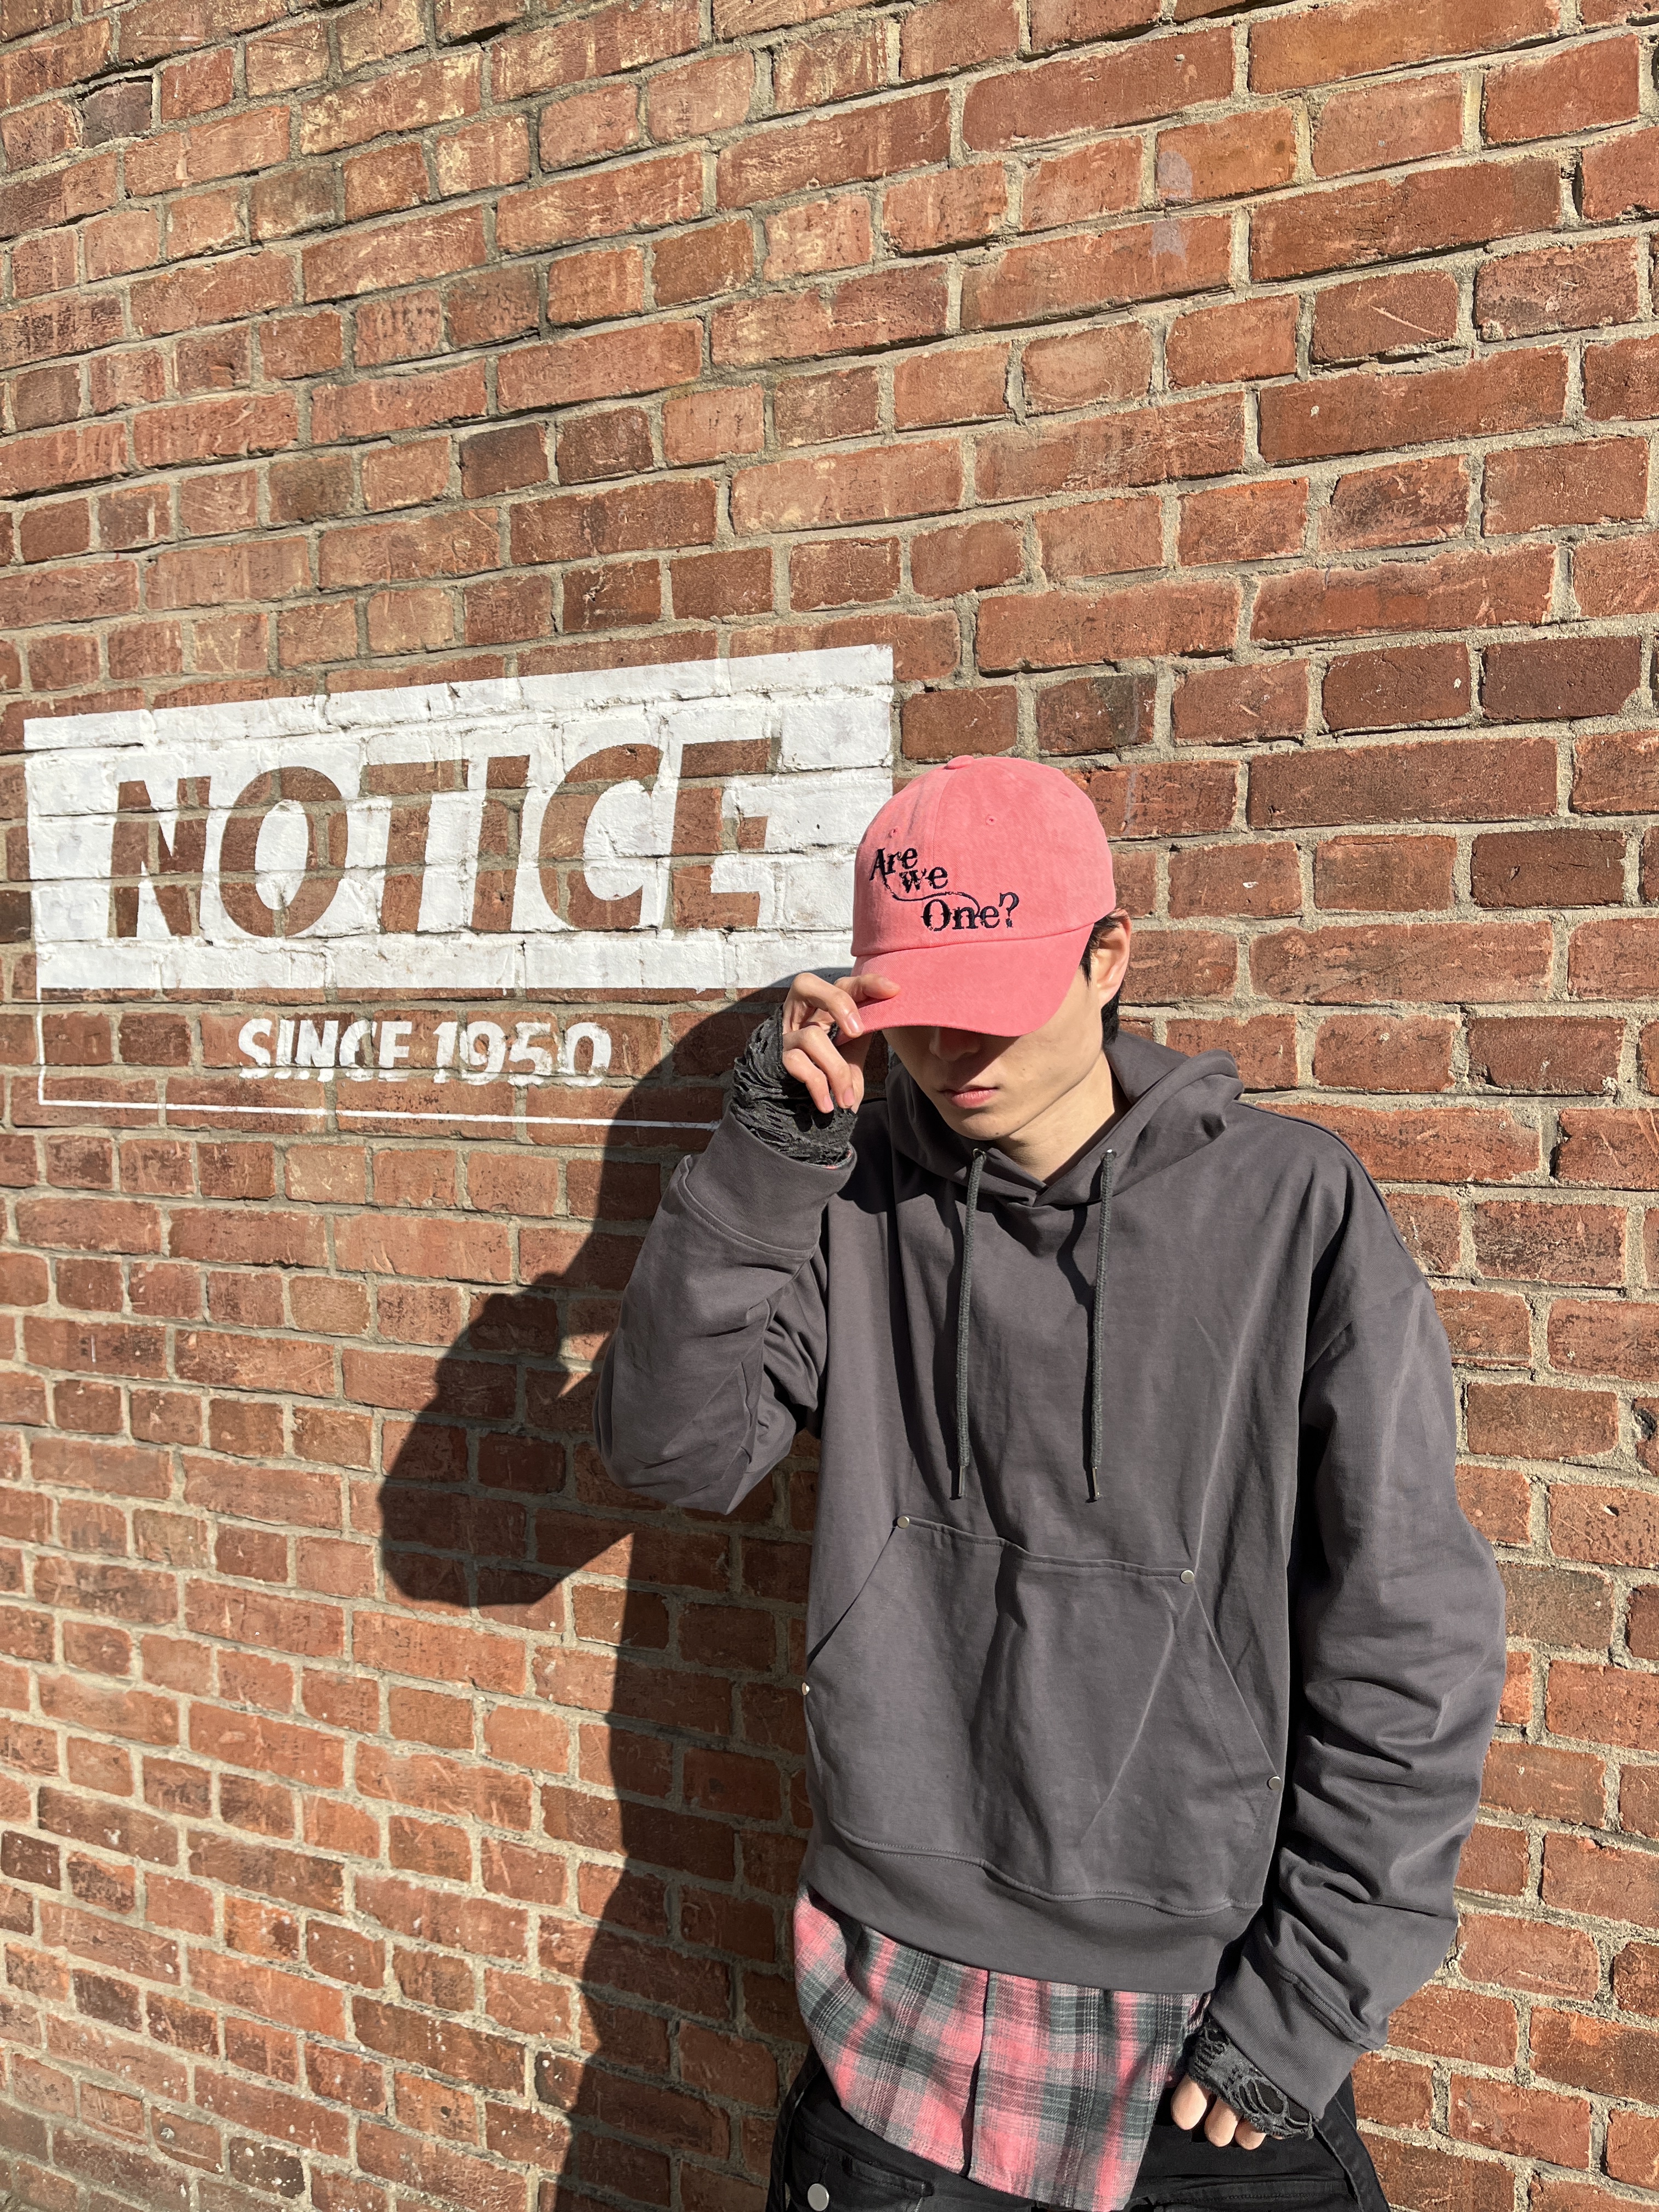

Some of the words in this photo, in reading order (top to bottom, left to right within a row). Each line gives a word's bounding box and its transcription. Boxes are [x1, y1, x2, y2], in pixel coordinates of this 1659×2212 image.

[109, 737, 782, 938] NOTICE
[869, 848, 918, 882] Are
[899, 866, 949, 894] we
[921, 892, 1020, 932] One?
[238, 1018, 413, 1083] SINCE
[432, 1020, 612, 1086] 1950
